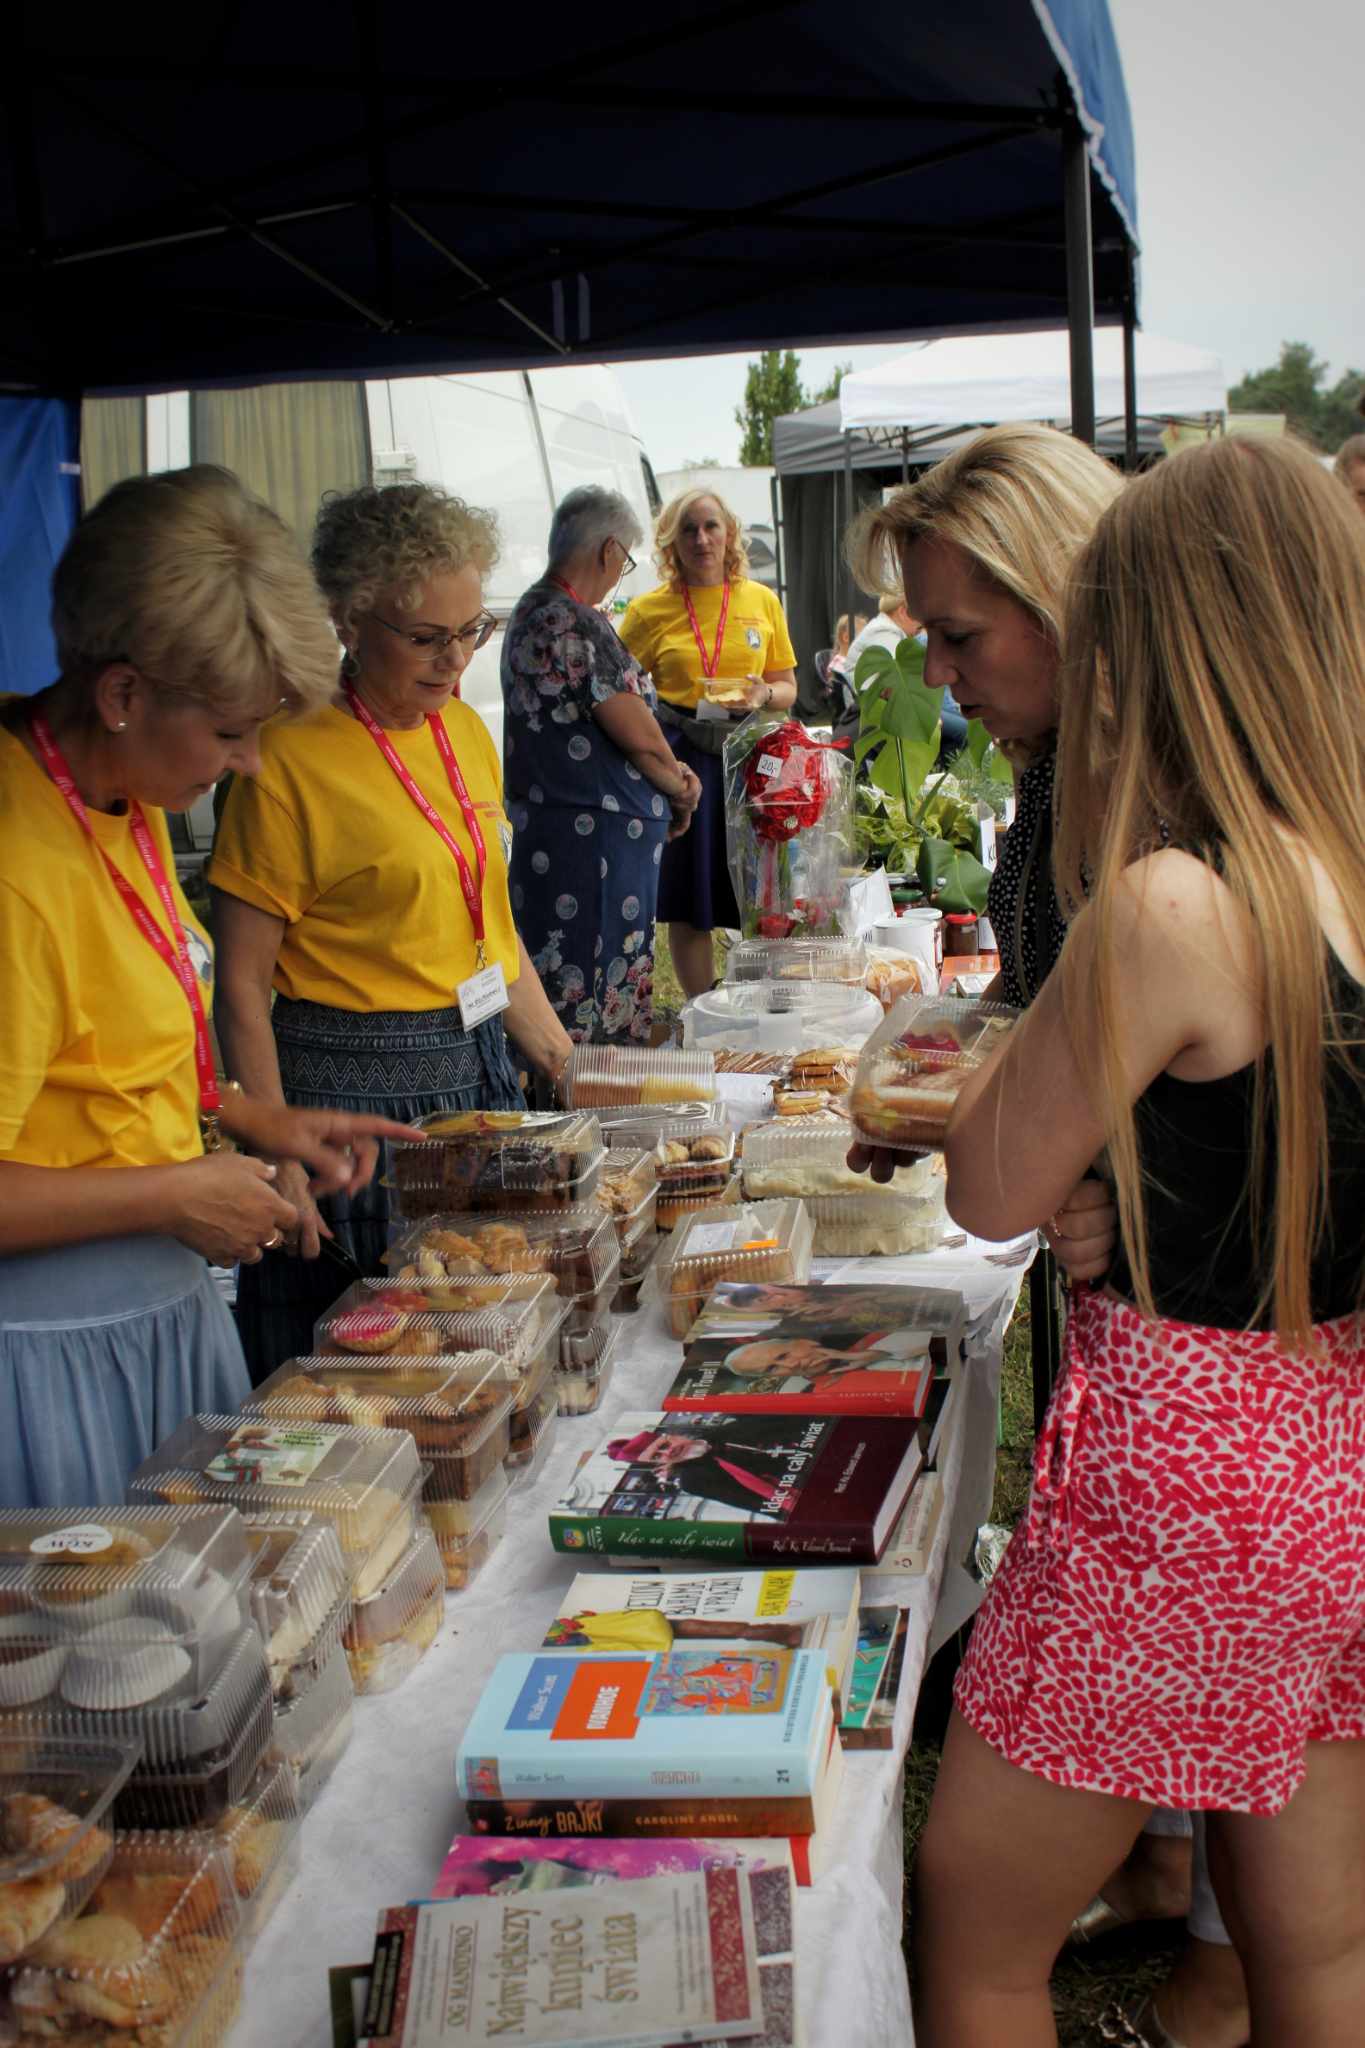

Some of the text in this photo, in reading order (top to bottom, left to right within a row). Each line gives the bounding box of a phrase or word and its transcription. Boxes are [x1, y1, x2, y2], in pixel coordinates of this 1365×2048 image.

[784, 1473, 798, 1488] na
[617, 1527, 644, 1545] Idąc
[649, 1534, 665, 1544] na
[587, 1685, 620, 1730] IVANHOE
[556, 1807, 604, 1833] BAJKI
[635, 1813, 739, 1826] CAROLINE ANGEL
[446, 1925, 473, 2028] OG MANDINO
[486, 1905, 541, 2038] Największy
[536, 1914, 583, 2014] kupiec
[589, 1910, 638, 2006] świata
